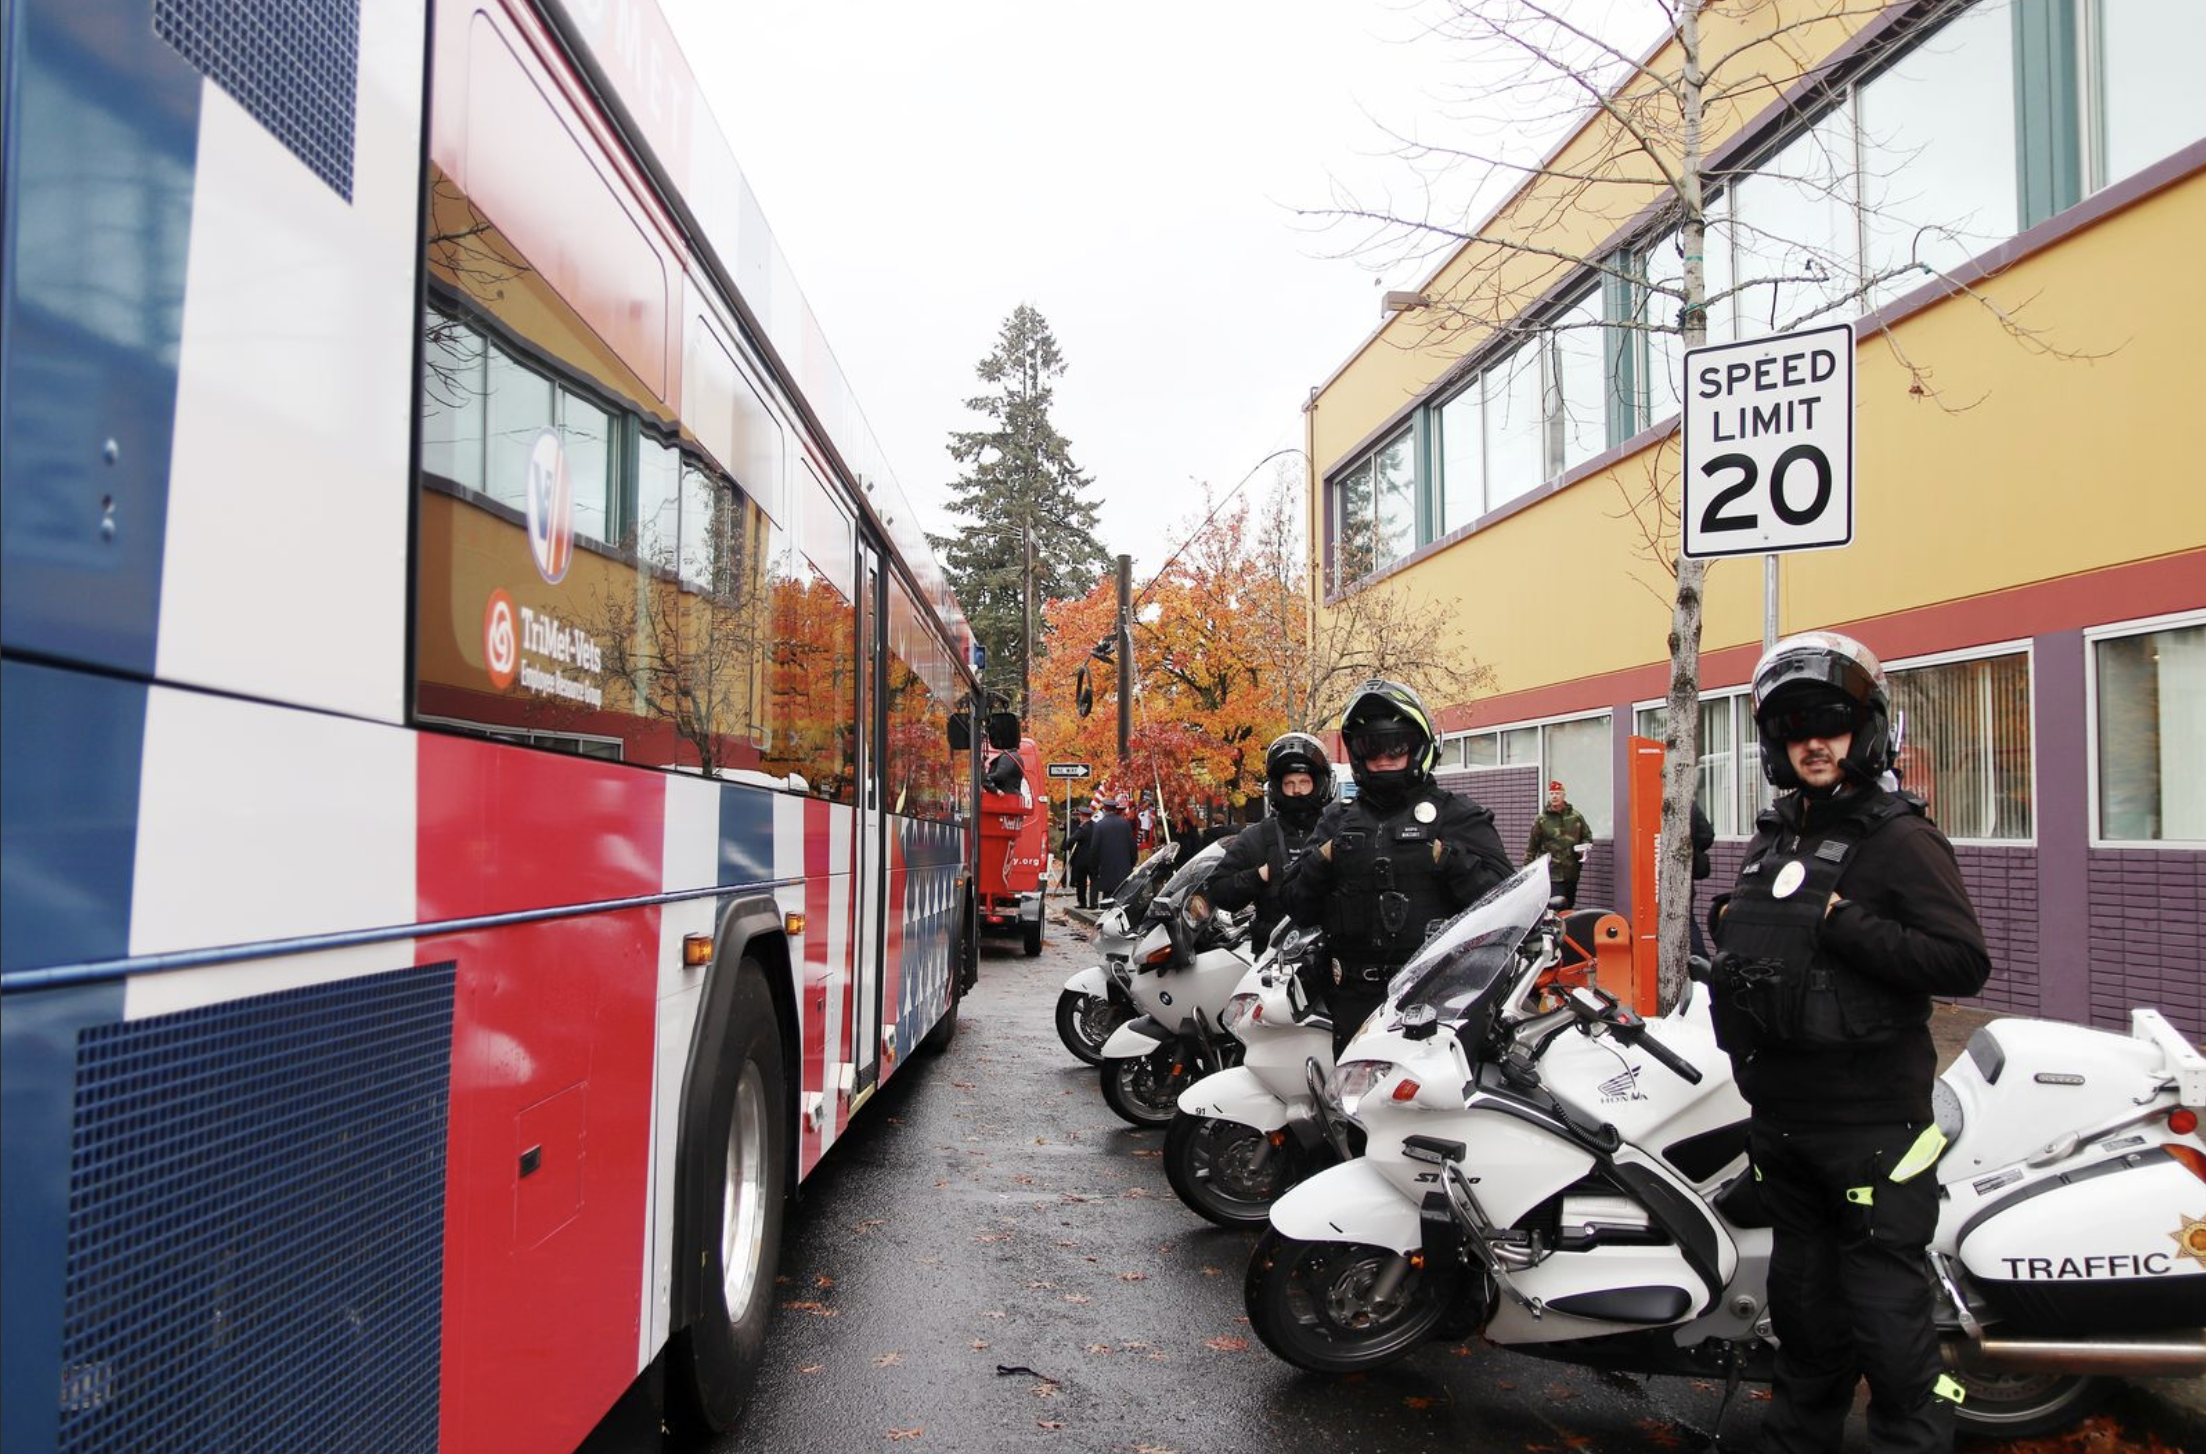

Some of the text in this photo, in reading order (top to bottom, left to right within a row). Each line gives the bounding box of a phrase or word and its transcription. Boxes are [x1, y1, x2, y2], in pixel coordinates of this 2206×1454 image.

[1698, 349, 1836, 399] SPEED
[1713, 396, 1821, 442] LIMIT
[1700, 444, 1832, 533] 20
[521, 606, 601, 674] TriMet-Vets
[1012, 857, 1040, 866] y.org
[2001, 1252, 2172, 1280] TRAFFIC
